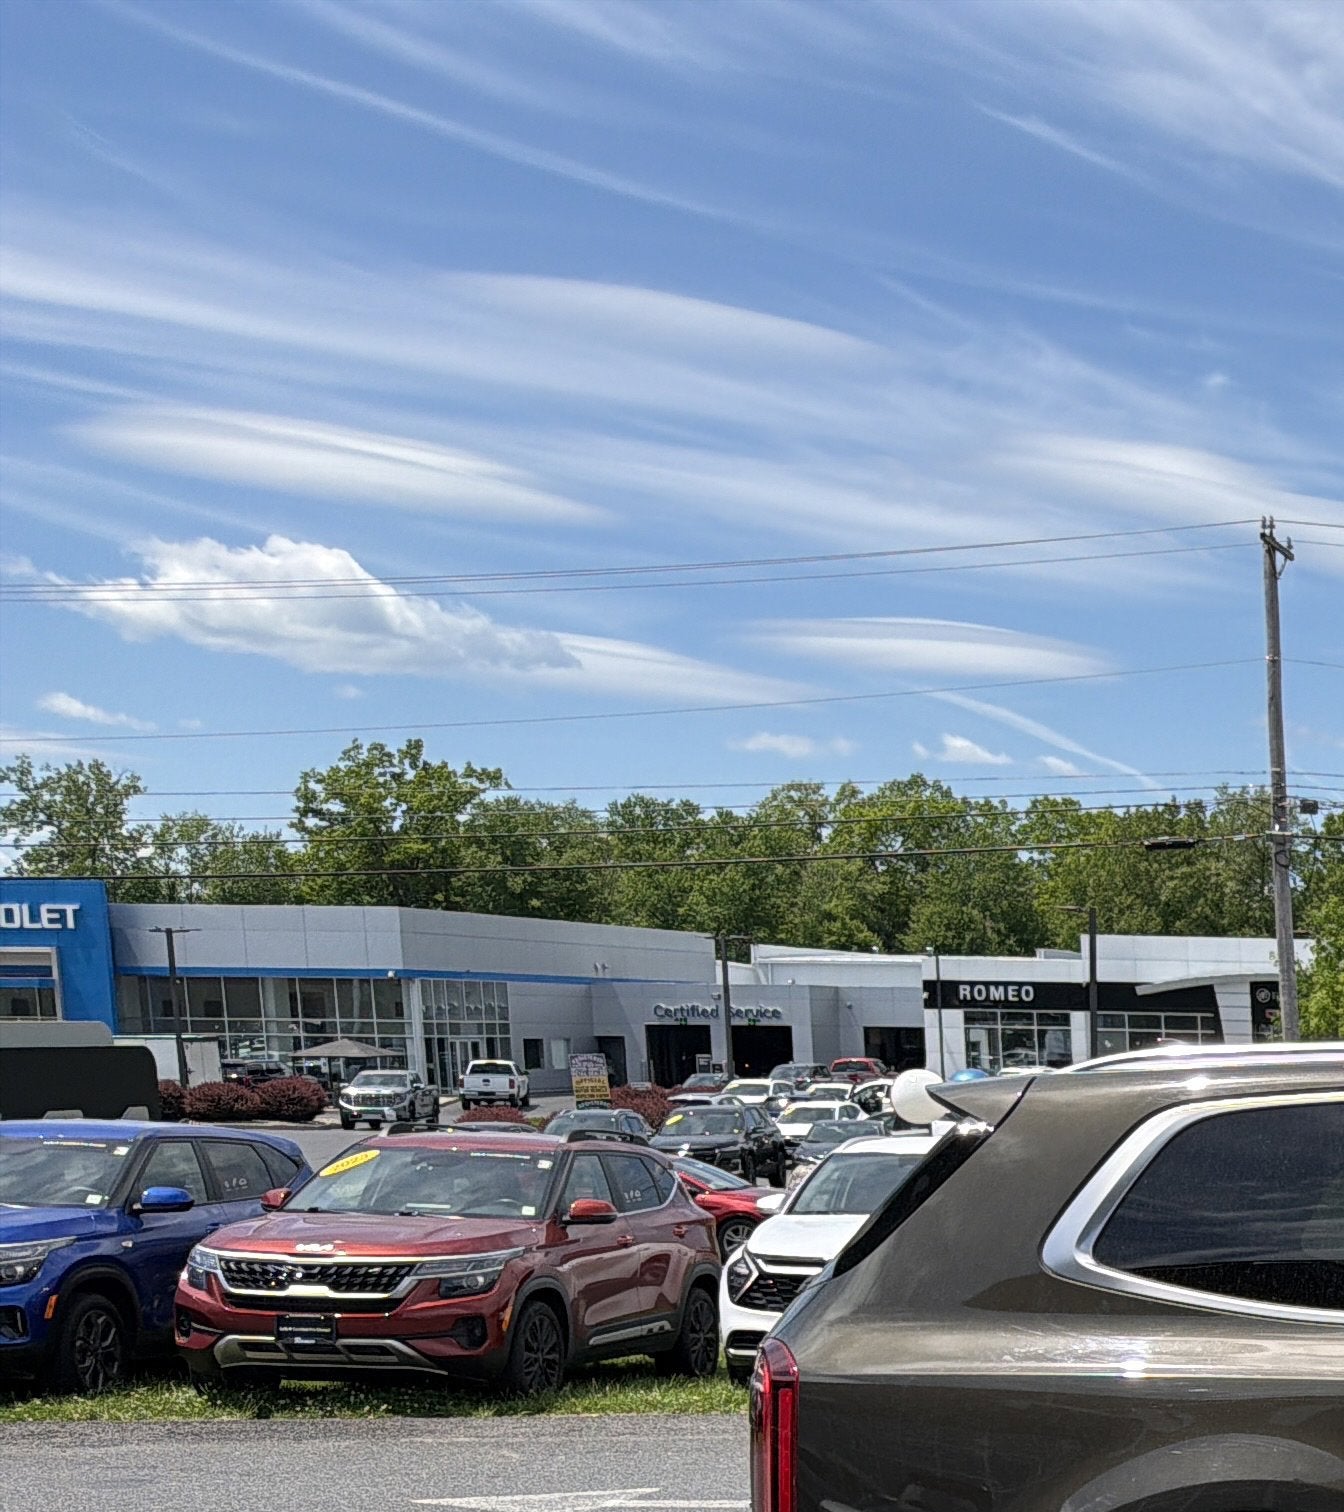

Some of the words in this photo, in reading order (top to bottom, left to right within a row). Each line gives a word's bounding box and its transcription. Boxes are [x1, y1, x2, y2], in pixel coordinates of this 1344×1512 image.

[958, 984, 1034, 1002] ROMEO
[653, 1003, 719, 1018] Certified
[728, 1004, 782, 1019] Service
